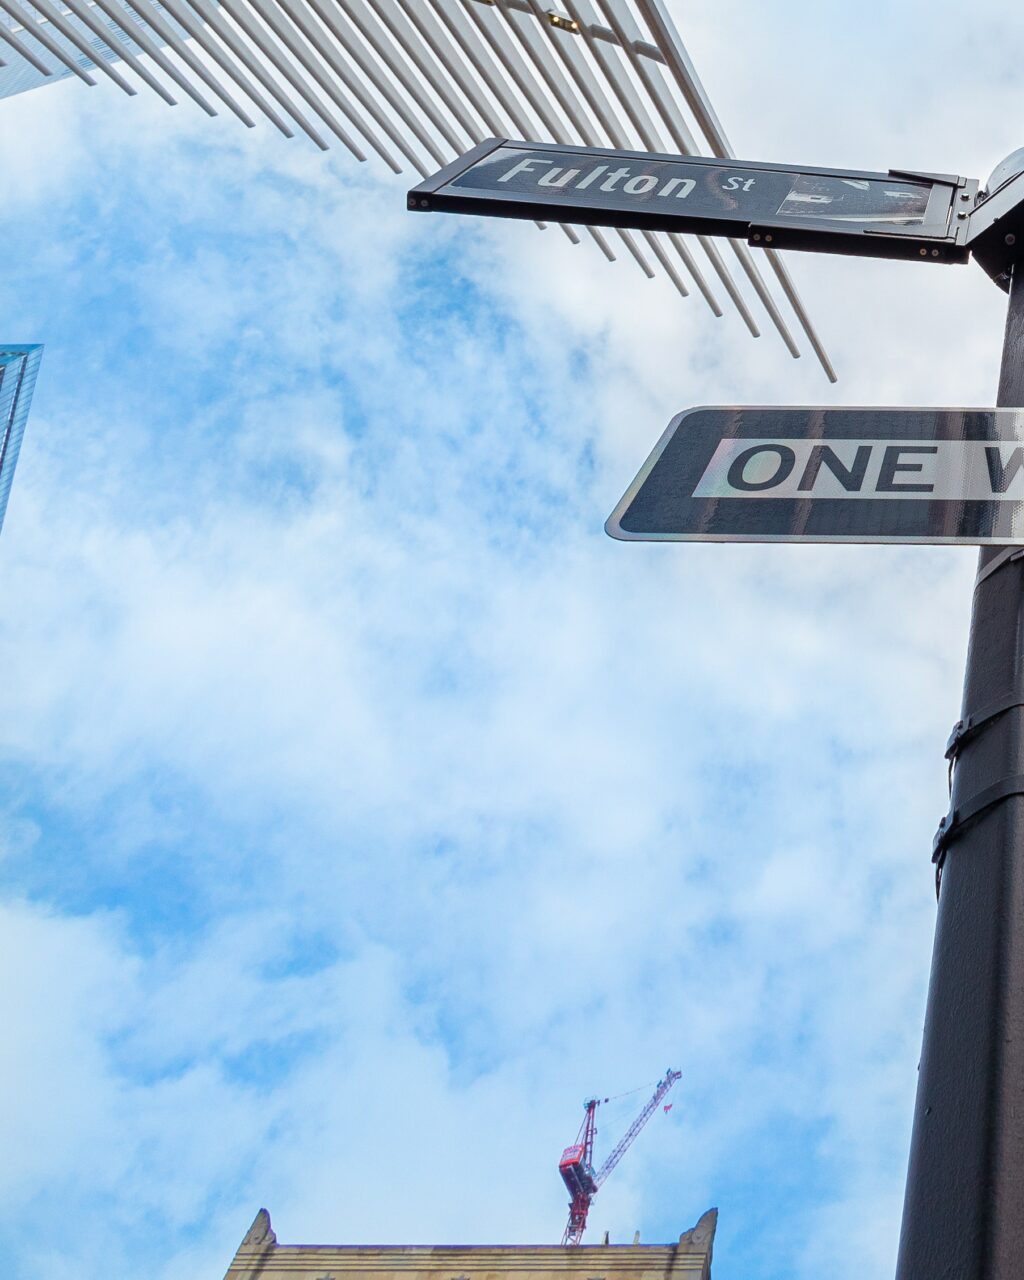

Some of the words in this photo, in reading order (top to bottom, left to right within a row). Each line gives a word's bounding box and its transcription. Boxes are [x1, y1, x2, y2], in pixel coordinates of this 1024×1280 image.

[497, 158, 697, 199] Fulton
[722, 176, 756, 192] St
[727, 443, 938, 492] ONE
